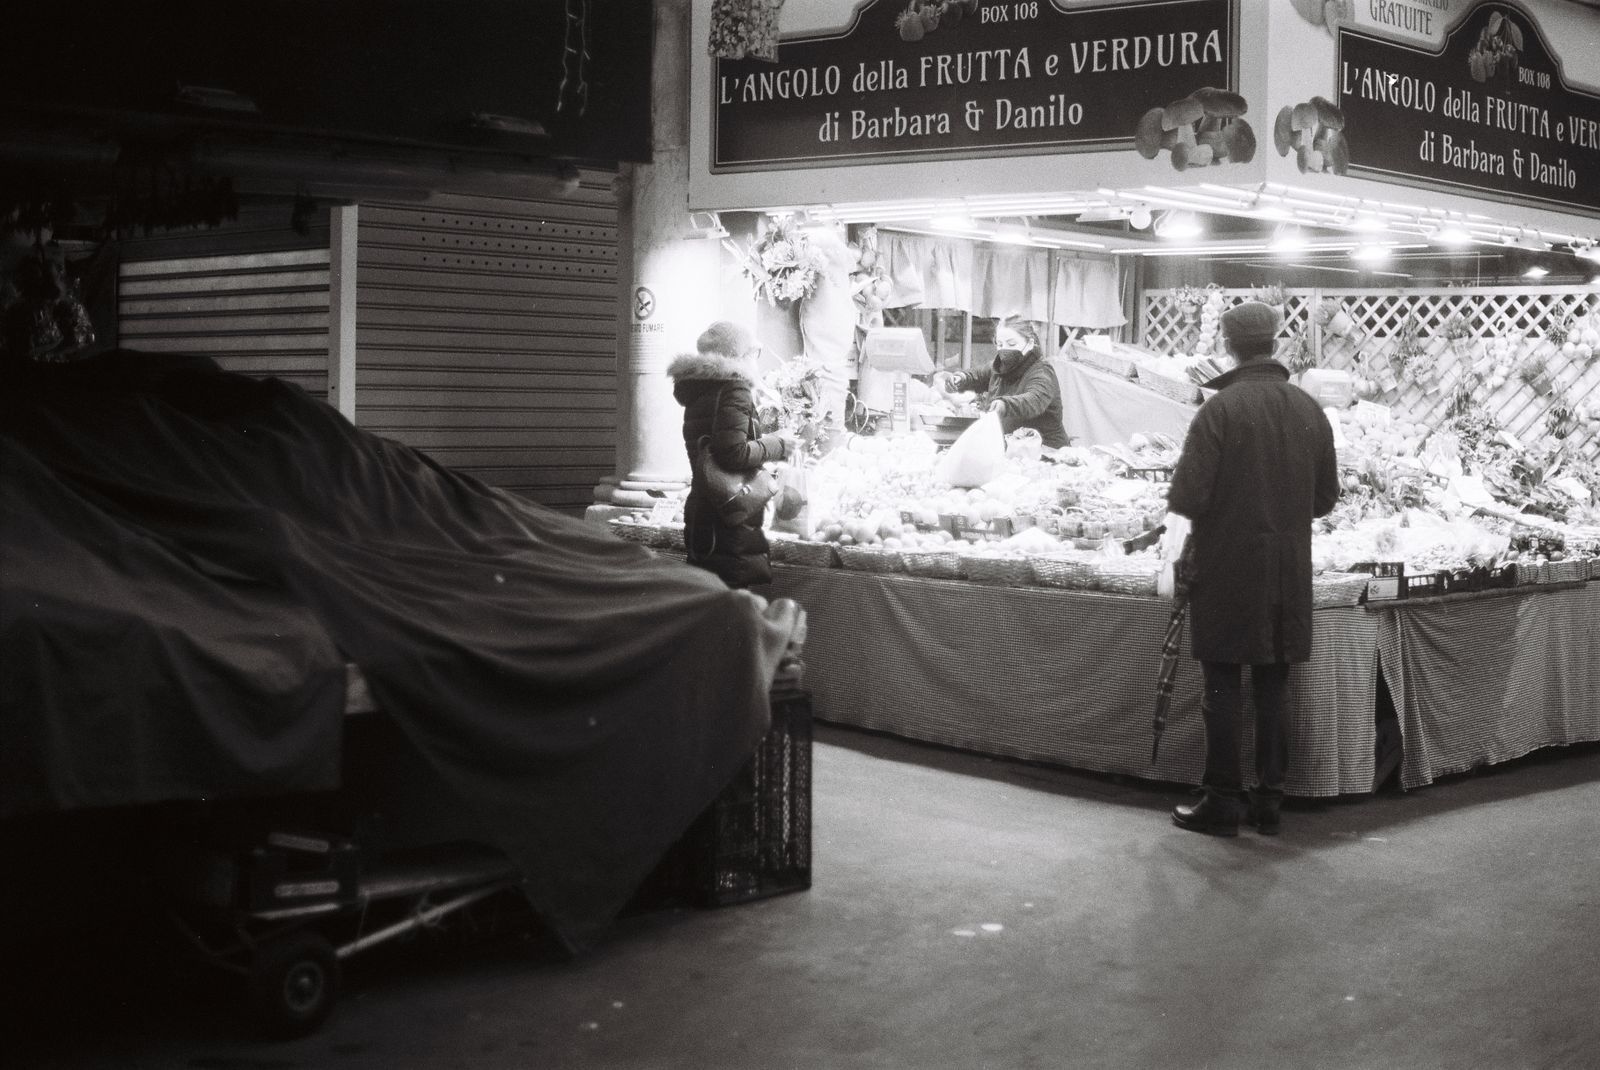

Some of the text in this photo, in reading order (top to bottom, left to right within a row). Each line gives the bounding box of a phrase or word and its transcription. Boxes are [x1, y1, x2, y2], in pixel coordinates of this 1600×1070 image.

[981, 2, 1039, 24] BOX 108
[1370, 0, 1432, 35] GRATUITE
[720, 29, 1223, 104] L'ANGOLO della FRUTTA e VERDURA
[1518, 66, 1550, 89] BOX 108
[818, 95, 1084, 142] di Barbara & Danilo
[1343, 62, 1436, 112] L'ANGOLO
[1443, 87, 1480, 123] della
[1486, 96, 1550, 138] FRUTTA
[1556, 120, 1564, 141] e
[1420, 131, 1577, 188] di Barbara & Danilo
